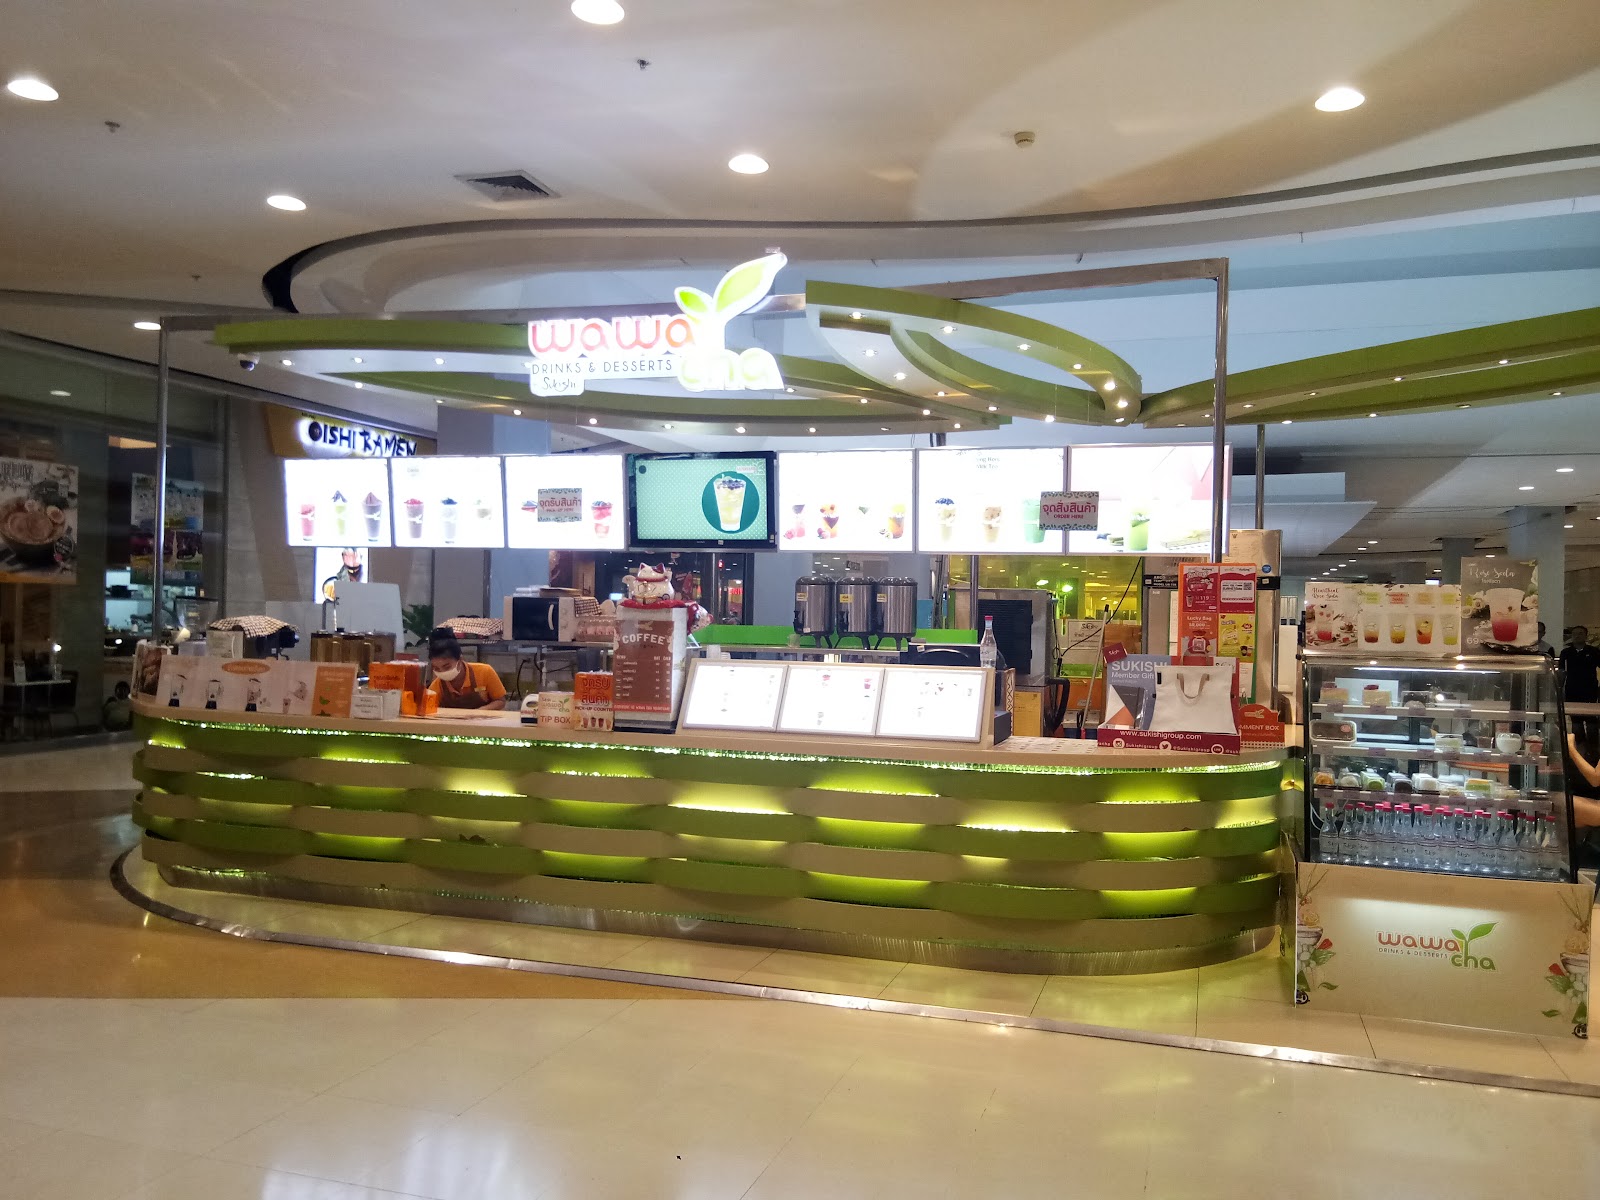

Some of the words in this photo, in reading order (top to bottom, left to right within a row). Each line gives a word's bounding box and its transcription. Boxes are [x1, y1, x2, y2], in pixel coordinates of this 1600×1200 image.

[531, 361, 582, 375] DRINKS
[588, 361, 596, 373] &
[603, 359, 673, 373] DESSERTS
[308, 421, 356, 450] OISHI
[359, 430, 418, 457] RAMEN
[1042, 500, 1097, 516] จุดสั่งสินค้า
[622, 633, 665, 645] COFFEE
[554, 716, 571, 724] BOX
[1120, 730, 1202, 741] www.sukishigroup.com
[1378, 932, 1460, 953] wawa
[1378, 947, 1404, 955] DRINKS
[1413, 950, 1448, 960] DESSERTS
[1450, 946, 1497, 971] cha
